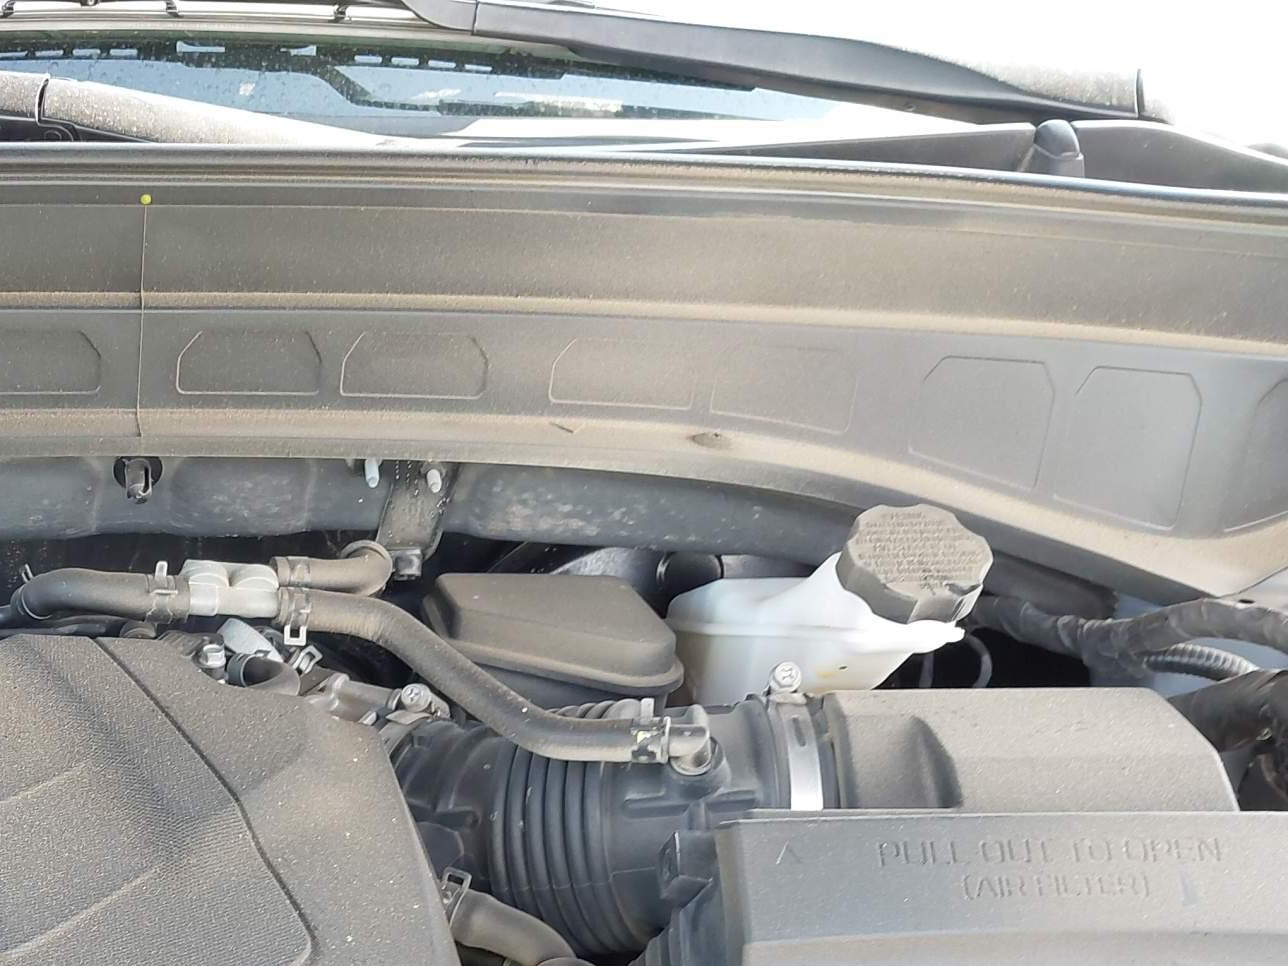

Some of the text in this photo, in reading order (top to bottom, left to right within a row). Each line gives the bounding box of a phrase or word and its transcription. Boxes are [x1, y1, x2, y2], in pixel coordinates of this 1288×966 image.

[878, 837, 1223, 867] PULL OUT TO OPEN
